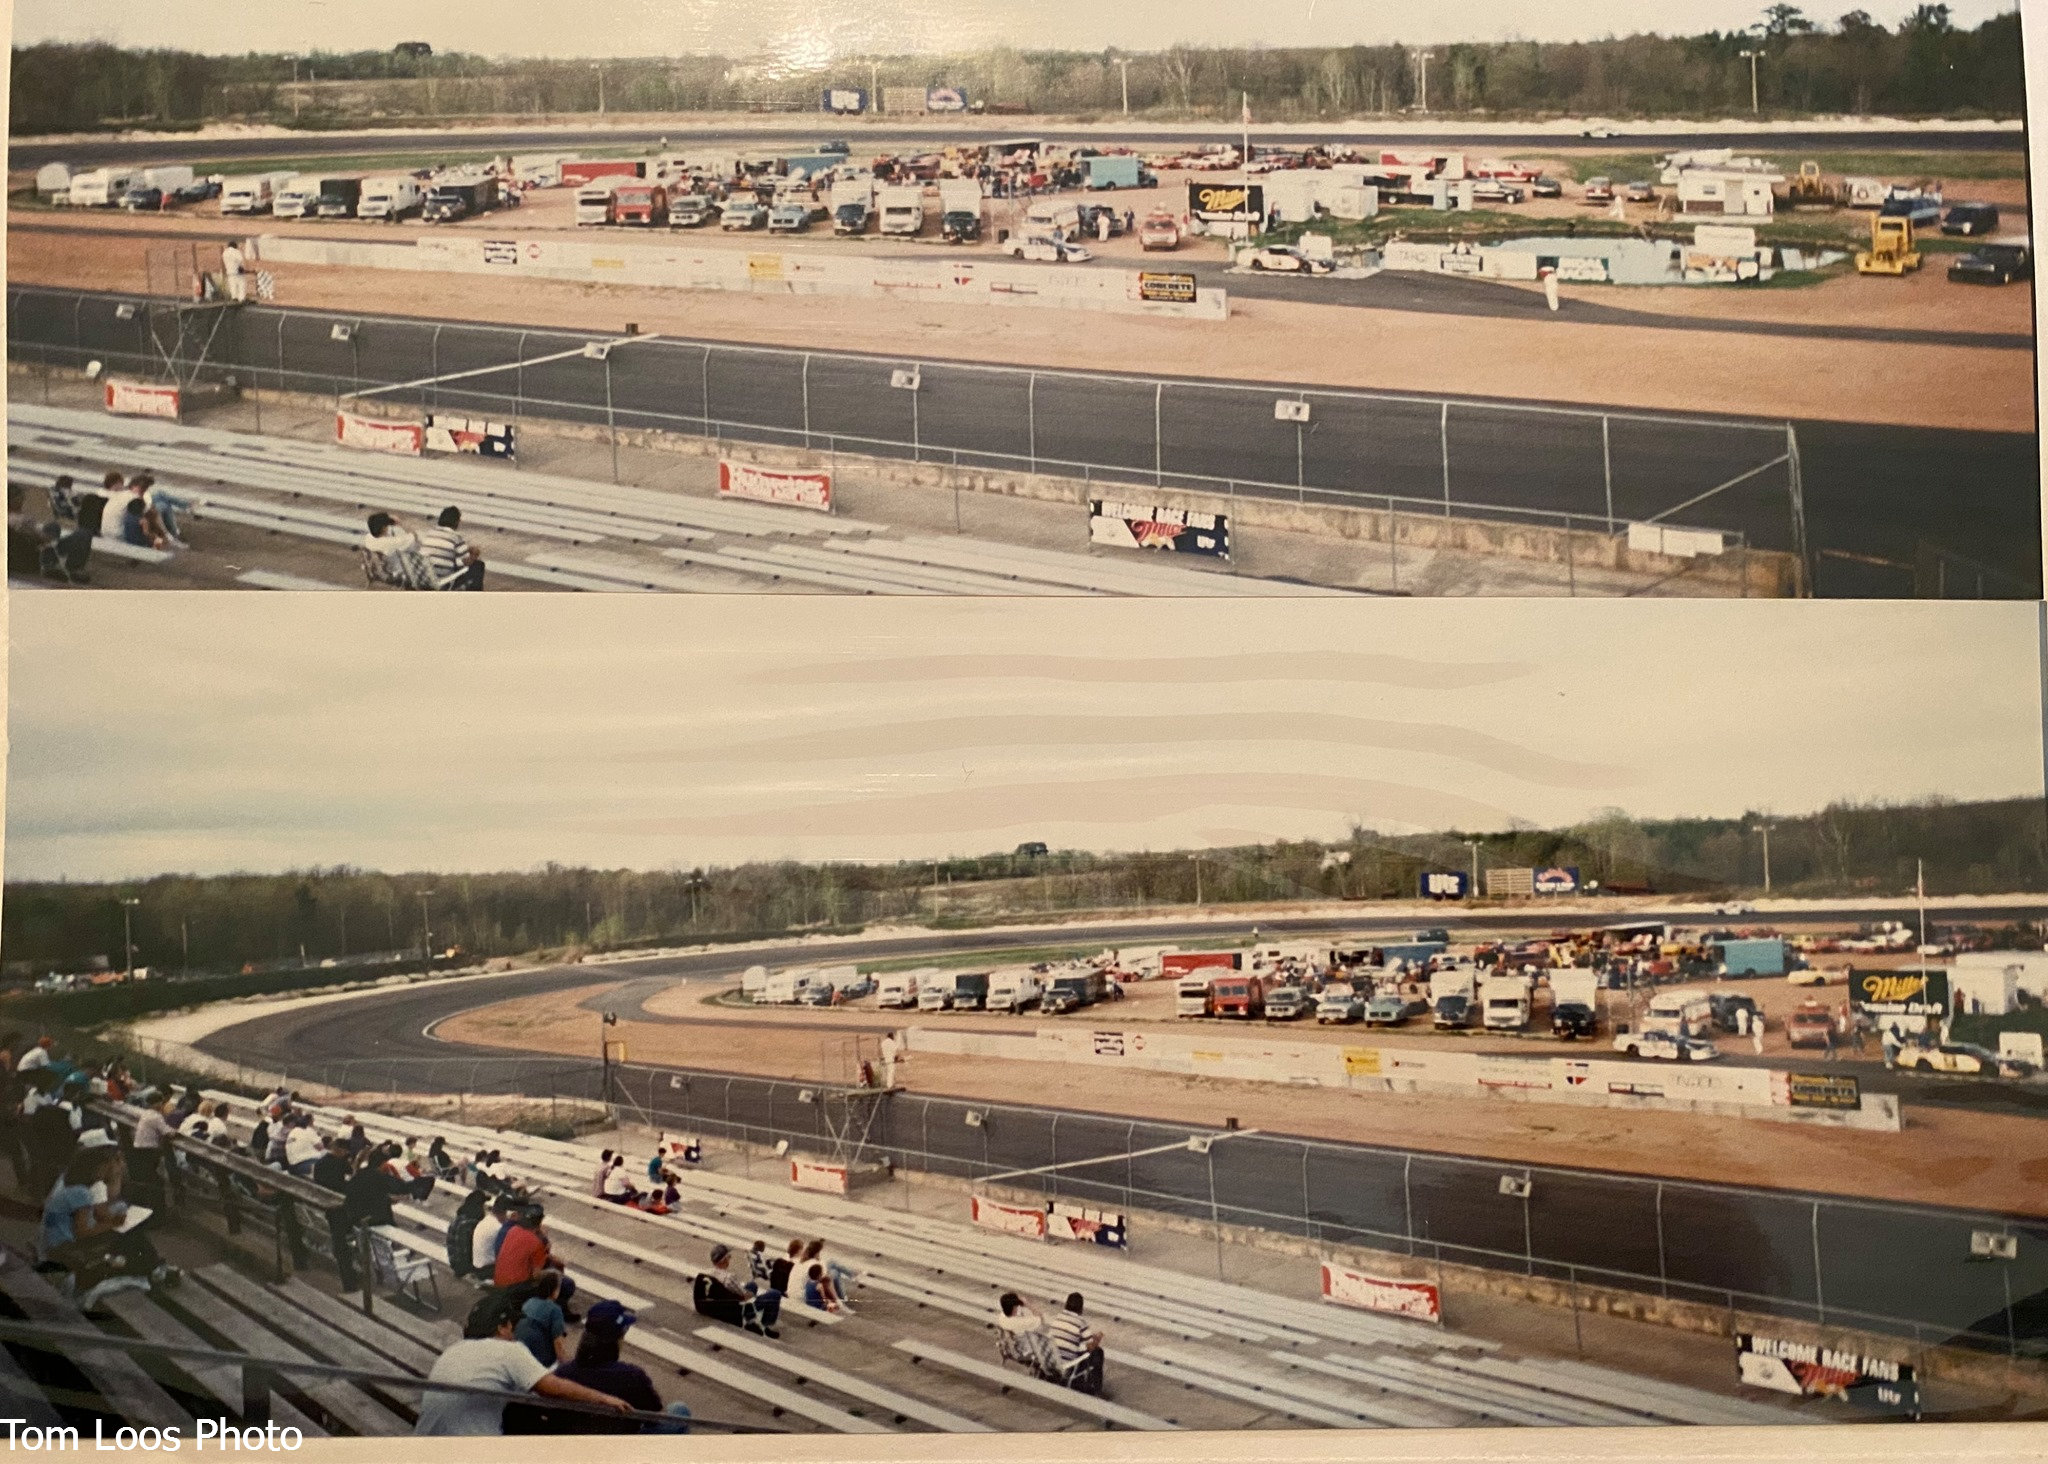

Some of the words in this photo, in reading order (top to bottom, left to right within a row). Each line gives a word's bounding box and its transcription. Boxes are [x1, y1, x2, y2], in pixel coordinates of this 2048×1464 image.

[1751, 1335, 1818, 1365] WELCOME
[1821, 1348, 1858, 1372] RACE
[1861, 1355, 1900, 1382] FANS
